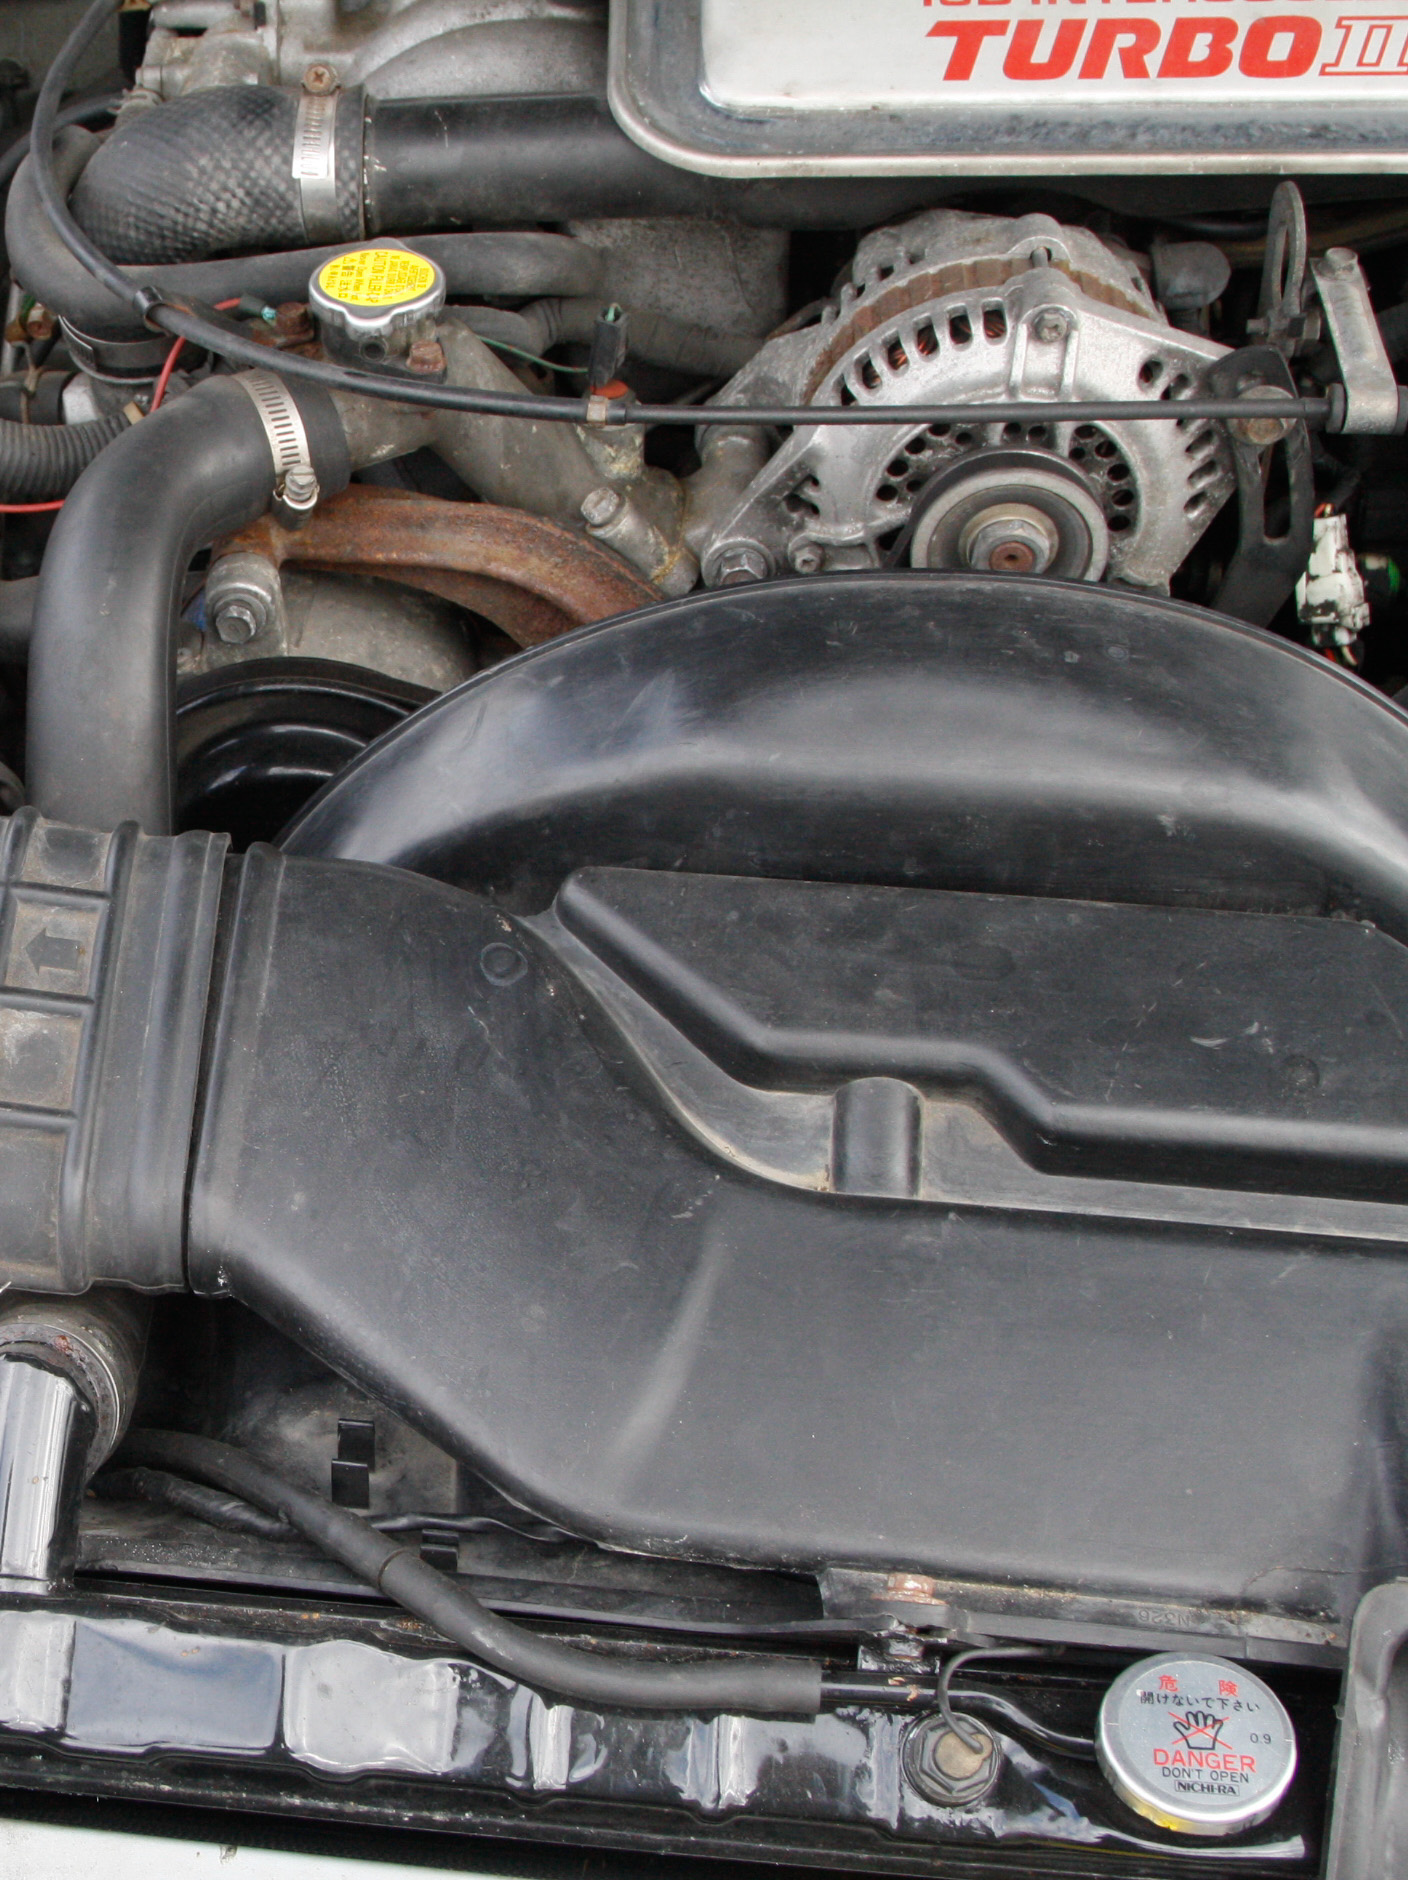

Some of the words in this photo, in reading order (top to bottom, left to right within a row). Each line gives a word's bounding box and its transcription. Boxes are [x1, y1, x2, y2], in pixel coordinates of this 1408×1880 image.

[925, 15, 1323, 81] TURBO
[1140, 1690, 1261, 1712] 開けないで下さい
[1153, 1748, 1257, 1774] DANGER
[1162, 1766, 1203, 1780] DON'T
[1210, 1770, 1250, 1783] OPEN
